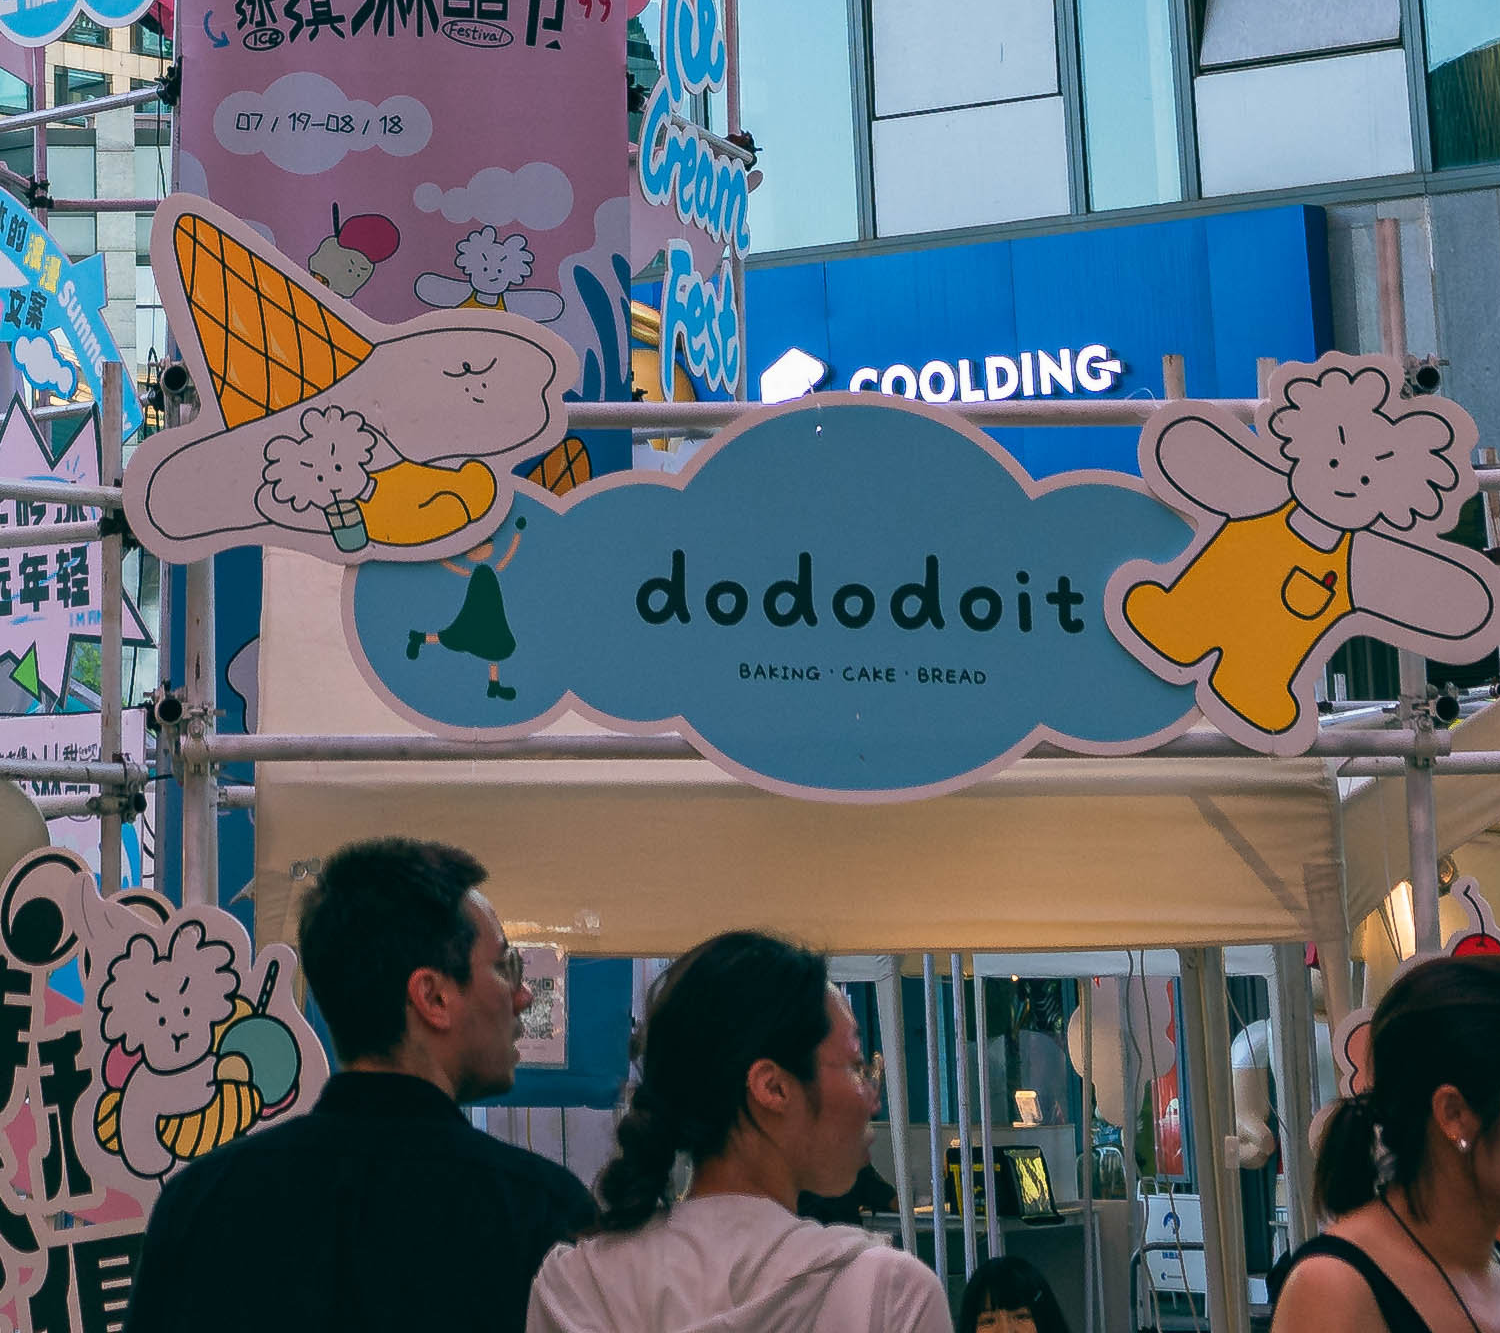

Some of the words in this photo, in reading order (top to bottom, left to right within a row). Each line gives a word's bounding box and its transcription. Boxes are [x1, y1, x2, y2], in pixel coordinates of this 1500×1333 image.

[663, 241, 741, 401] Fest
[849, 343, 1122, 403] COOLDING
[635, 549, 1085, 634] dododoit
[738, 661, 821, 684] BAKING
[842, 663, 897, 684] CAKE
[916, 665, 988, 687] BREAD
